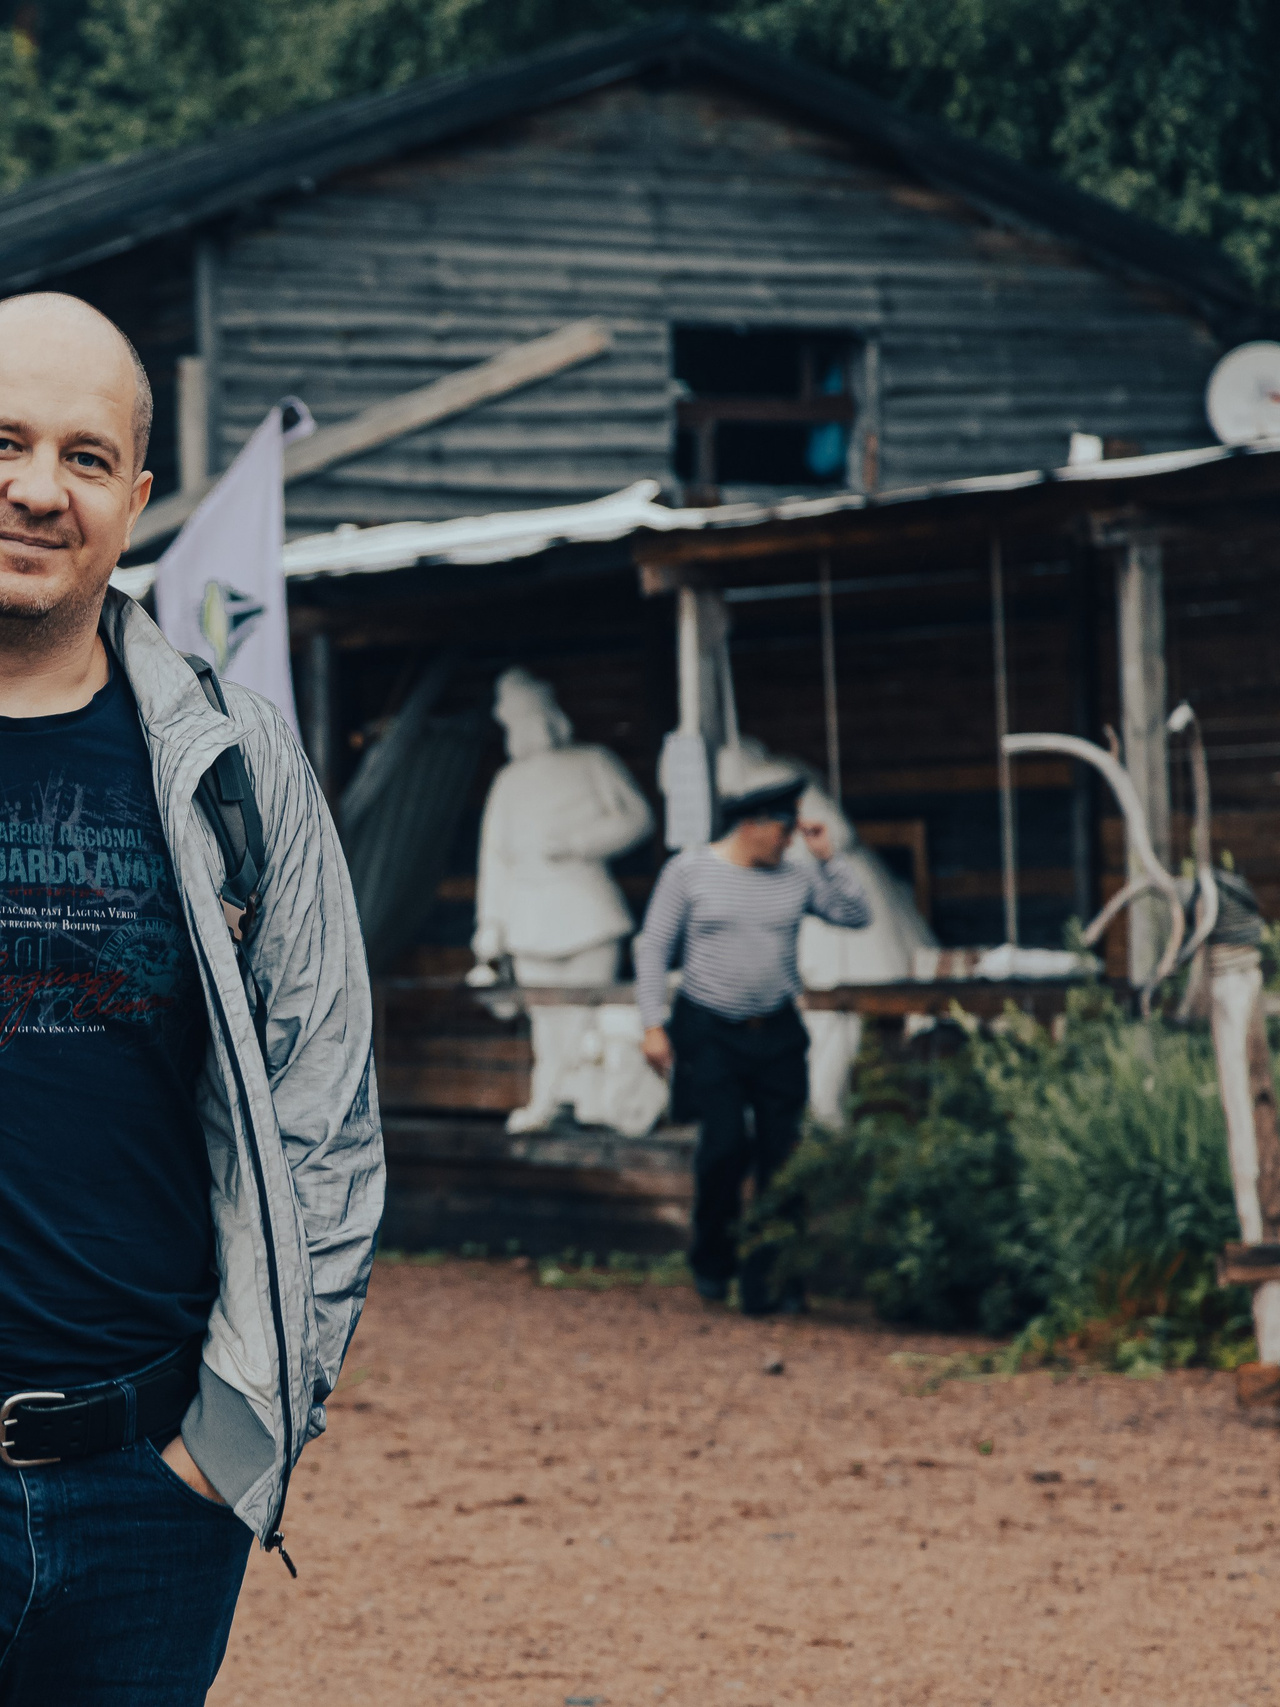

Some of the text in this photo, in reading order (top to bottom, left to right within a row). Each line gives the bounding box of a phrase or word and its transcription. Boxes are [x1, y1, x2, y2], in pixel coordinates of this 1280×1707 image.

[60, 824, 143, 848] NACIONAL
[41, 906, 63, 917] PAST
[66, 905, 106, 918] LAGUNA
[107, 907, 139, 920] VERDE
[9, 920, 42, 930] REGION
[45, 921, 57, 930] OF
[61, 919, 101, 932] BOLIVIA
[49, 1024, 106, 1034] ENCANTADA
